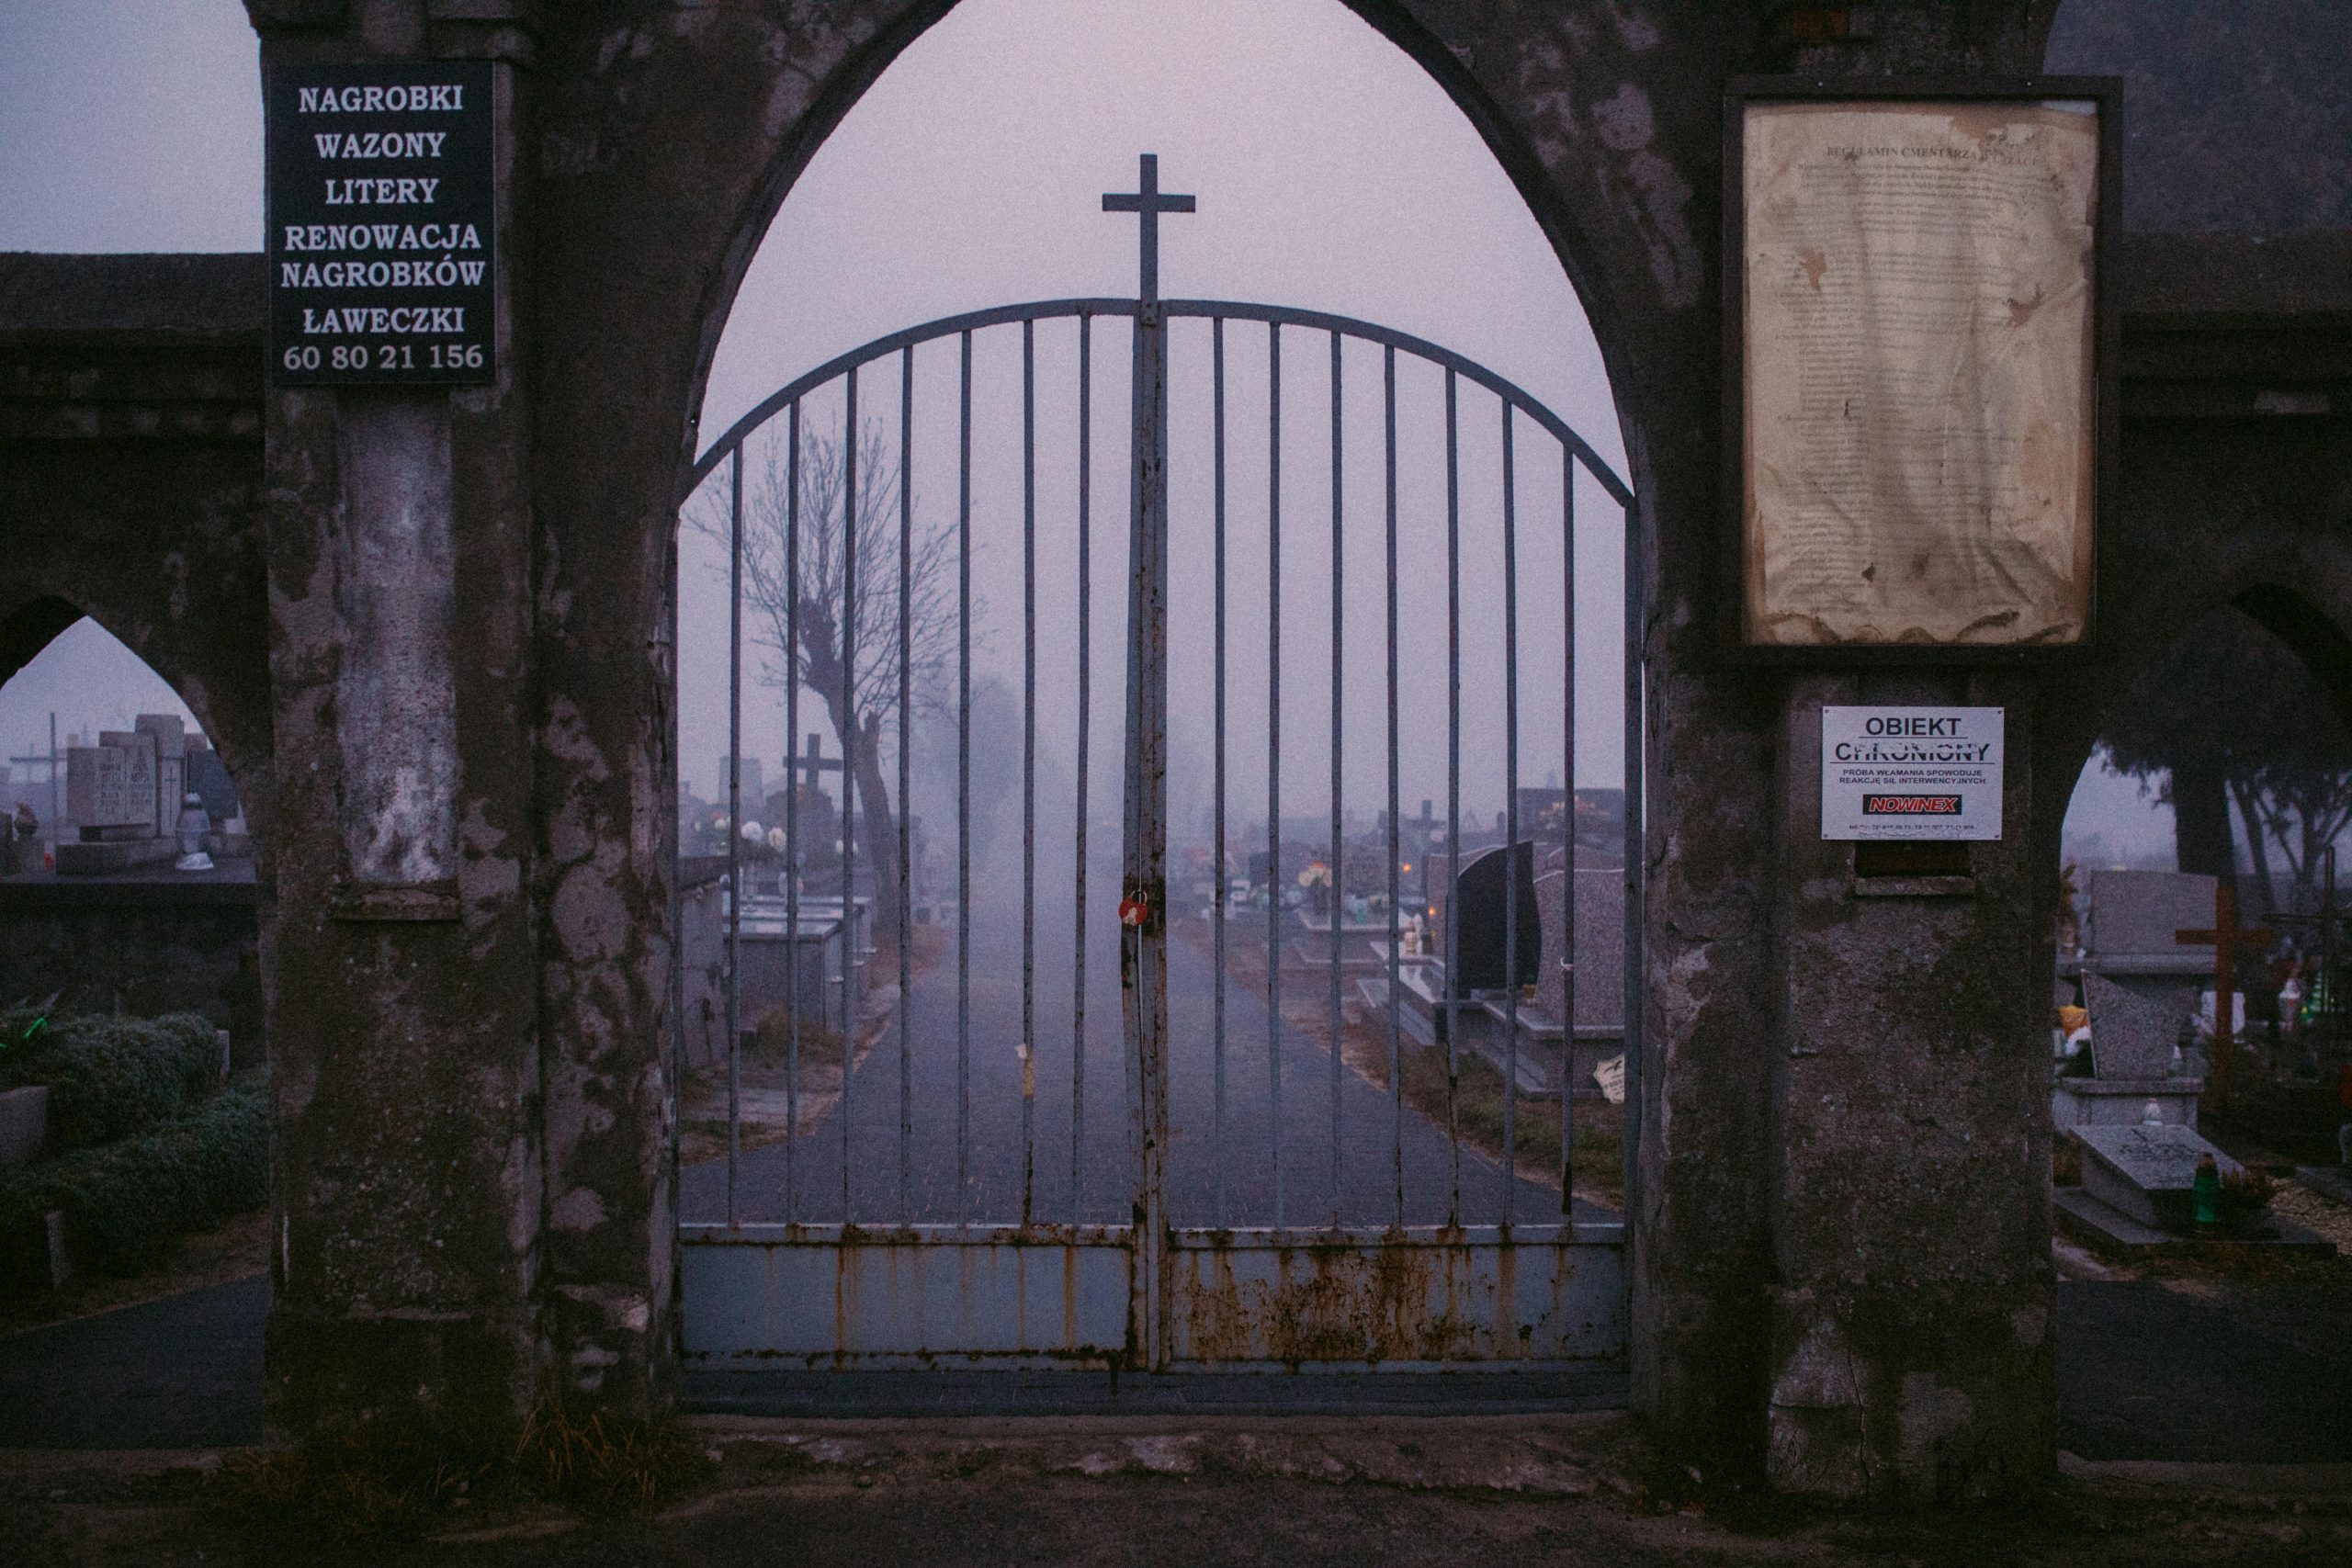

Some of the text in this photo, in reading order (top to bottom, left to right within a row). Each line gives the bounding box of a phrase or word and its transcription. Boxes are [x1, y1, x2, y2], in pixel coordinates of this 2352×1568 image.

[299, 85, 463, 113] NAGROBKI
[314, 132, 447, 158] WAZONY
[325, 178, 439, 204] LITERY
[285, 224, 481, 251] RENOWACJA
[280, 254, 486, 288] NAGROBKÓW
[302, 307, 465, 333] ŁAWECZKI
[283, 344, 484, 370] 60 80 21 156
[1865, 717, 1962, 736] OBIEKT
[1839, 777, 1881, 785] REAKCJĘ
[1898, 777, 1986, 785] INTERWENCYJNYCH
[1843, 768, 1875, 776] PRÓBA
[1926, 769, 1983, 777] SPOWODUJE
[1869, 796, 1959, 812] NOWINEX
